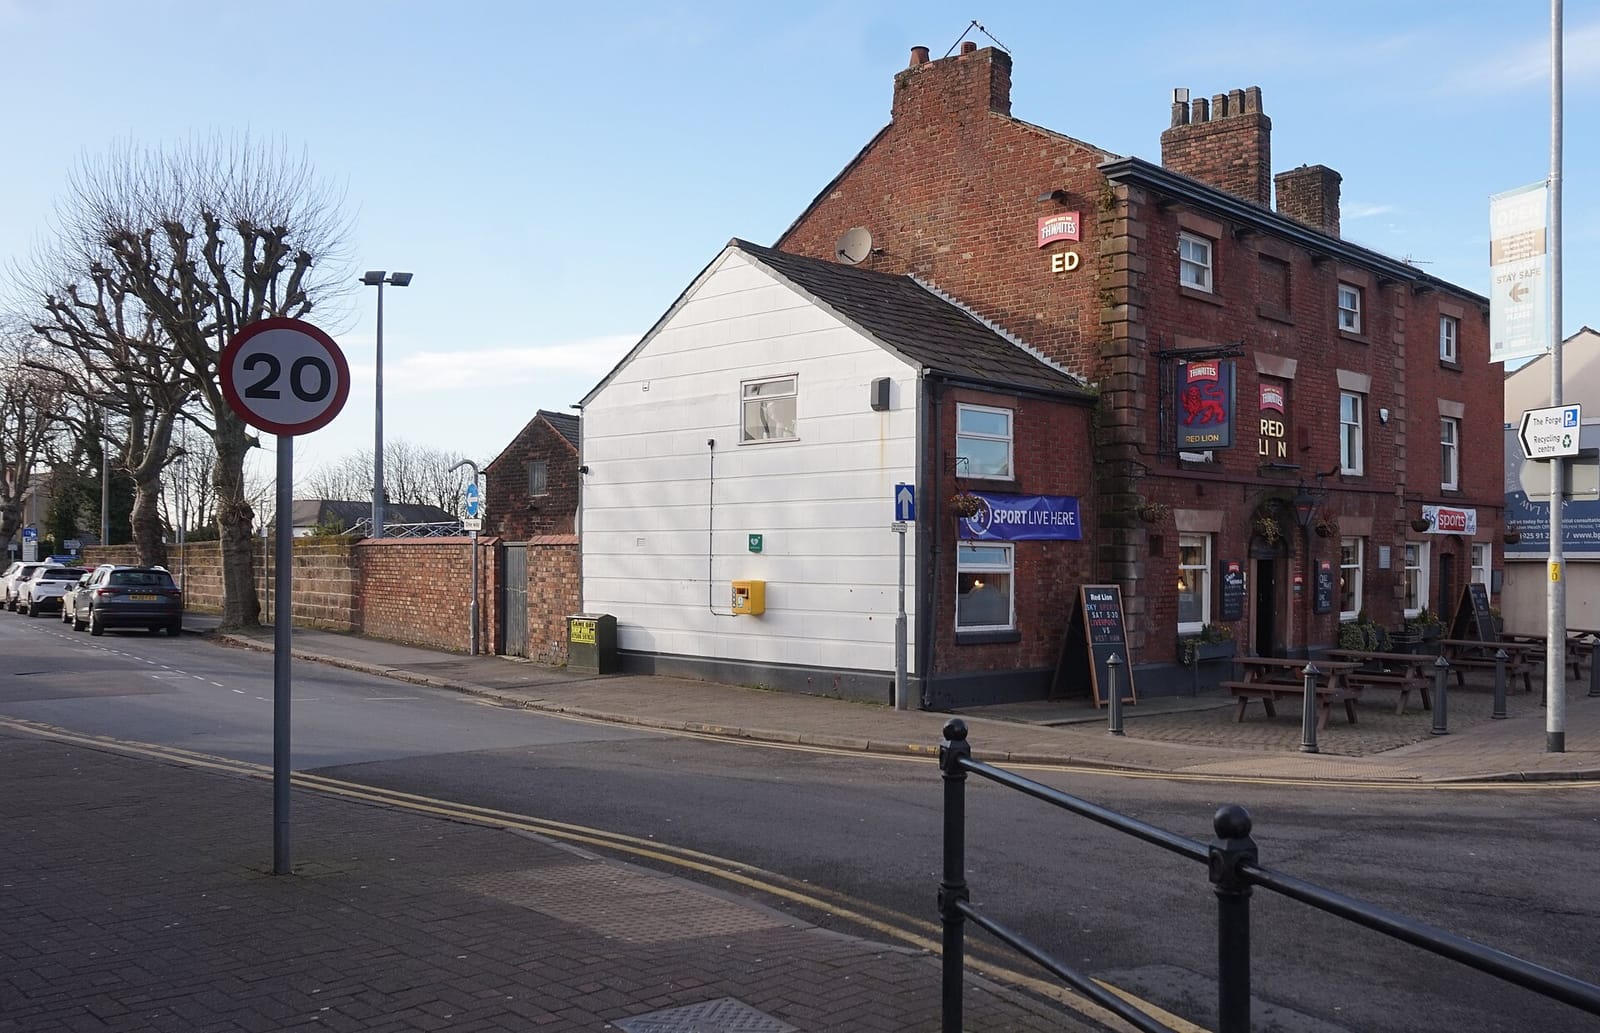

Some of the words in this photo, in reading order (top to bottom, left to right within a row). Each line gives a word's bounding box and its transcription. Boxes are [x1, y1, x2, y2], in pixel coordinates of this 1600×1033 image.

[1051, 251, 1079, 272] ED
[1496, 272, 1517, 284] STAY
[1519, 267, 1541, 279] SAFE
[243, 353, 331, 402] 20
[1545, 416, 1562, 425] Forge
[1260, 418, 1284, 438] RED
[1185, 435, 1200, 443] RED
[1201, 434, 1220, 443] LION
[1533, 434, 1561, 444] Recycling
[1538, 445, 1555, 453] centre
[993, 509, 1028, 525] SPORT
[1028, 510, 1050, 525] LIVE
[1050, 511, 1075, 526] HERE
[1439, 514, 1465, 528] sports
[1091, 611, 1103, 619] SAT
